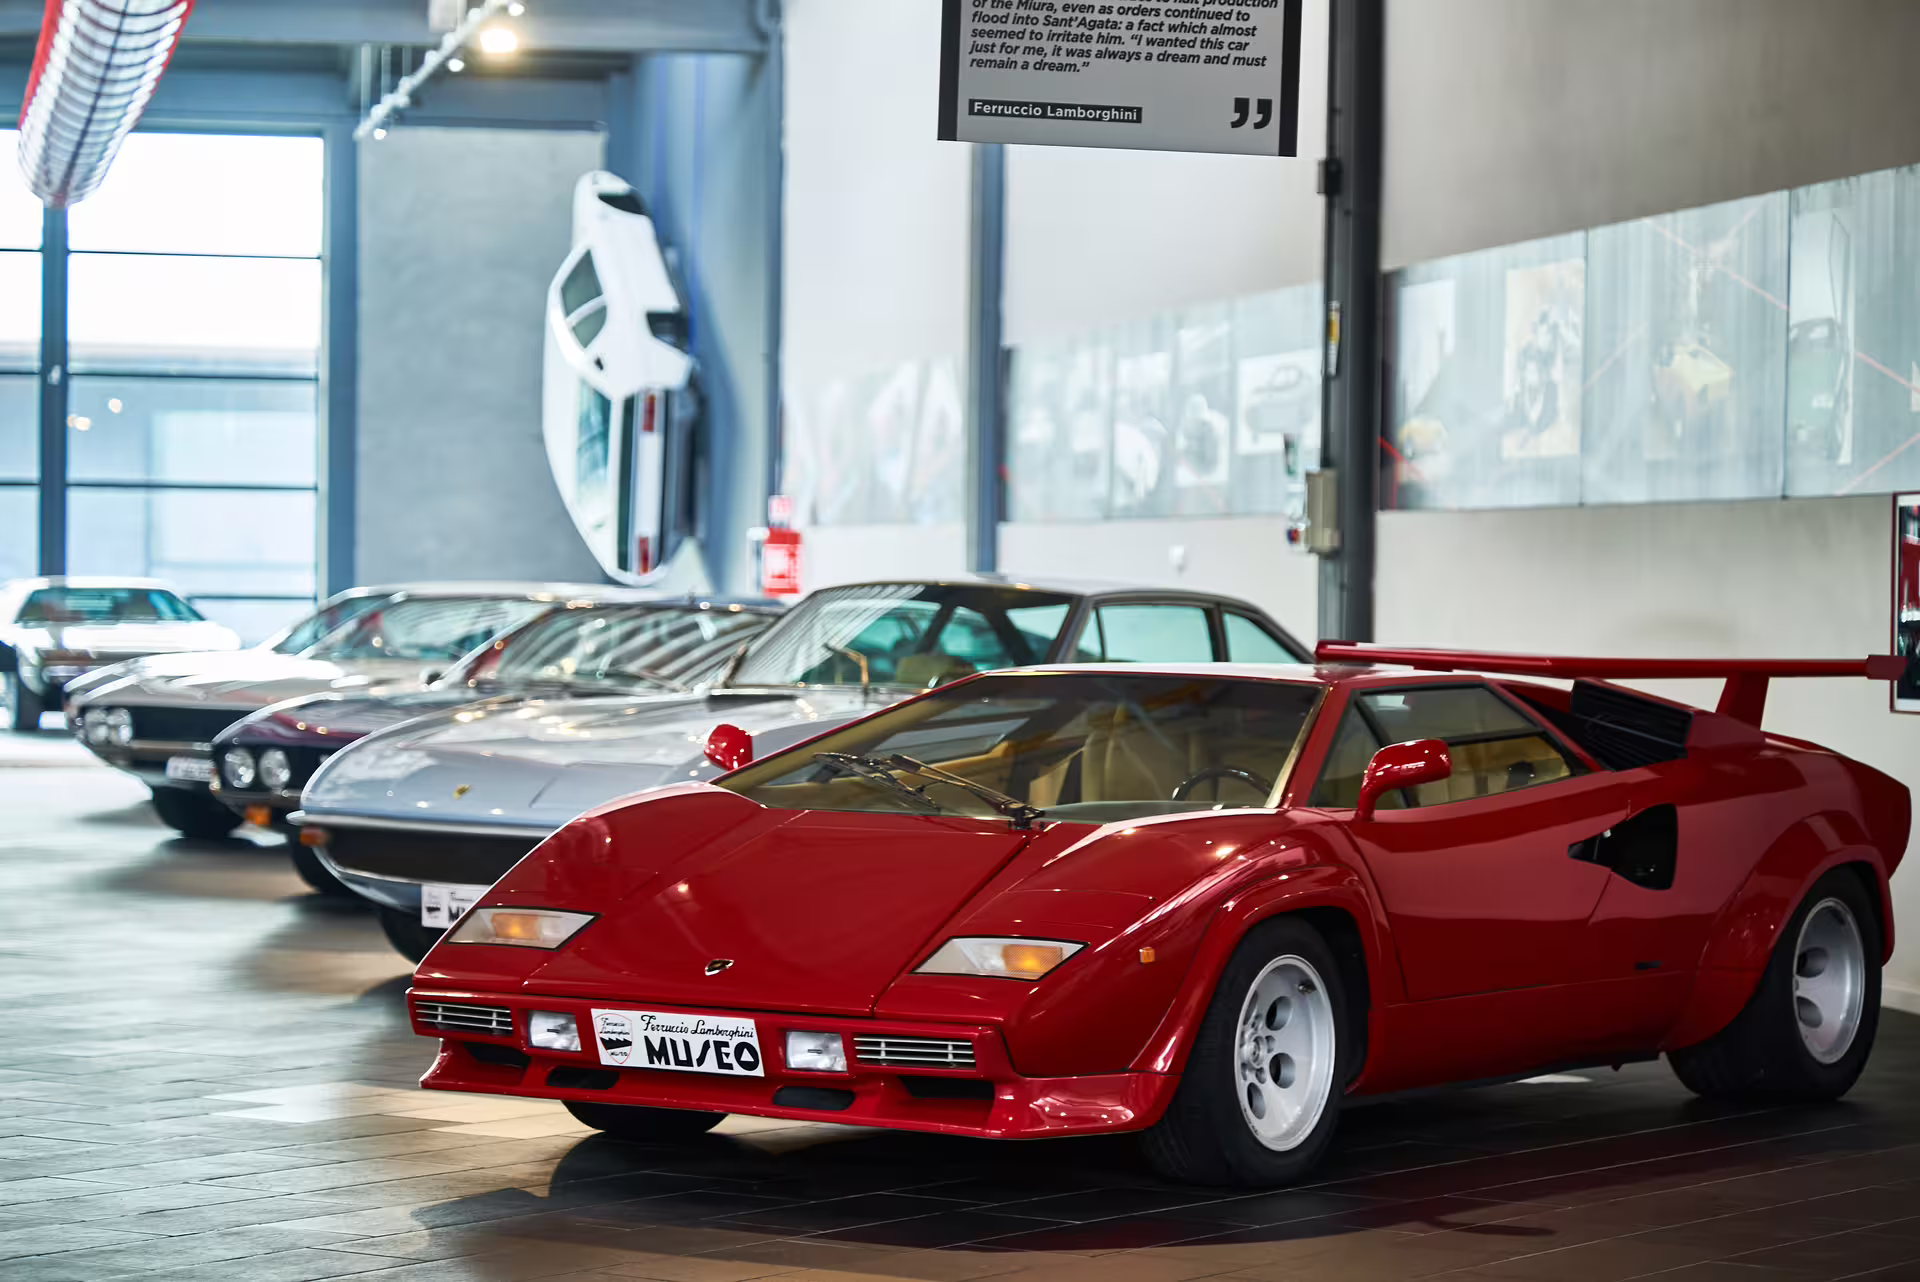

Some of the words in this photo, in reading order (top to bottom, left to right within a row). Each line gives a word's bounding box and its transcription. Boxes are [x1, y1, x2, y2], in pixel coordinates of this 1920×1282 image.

[972, 0, 986, 8] of
[991, 0, 1013, 9] the
[1016, 0, 1057, 14] Miura,
[1062, 3, 1095, 14] even
[1098, 5, 1114, 15] as
[1117, 4, 1161, 17] orders
[1164, 7, 1233, 21] continued
[1236, 10, 1250, 22] to
[972, 11, 1010, 24] flood
[1012, 13, 1039, 26] into
[1125, 20, 1134, 31] a
[1137, 19, 1164, 32] fact
[1168, 21, 1207, 35] which
[1210, 24, 1257, 36] almost
[971, 27, 1026, 40] seemed
[1028, 29, 1043, 41] to
[1047, 29, 1093, 43] irritate
[1096, 31, 1125, 45] him.
[1146, 35, 1197, 49] wanted
[1200, 37, 1224, 50] this
[1227, 40, 1250, 51] car
[968, 41, 996, 54] just
[999, 42, 1020, 55] for
[1022, 45, 1047, 58] me,
[1051, 45, 1062, 57] it
[1066, 48, 1092, 58] was
[1095, 48, 1142, 62] always
[1144, 52, 1153, 61] a
[1156, 50, 1200, 64] dream
[1203, 53, 1230, 65] and
[1232, 55, 1267, 67] must
[970, 57, 1018, 69] remain
[1020, 60, 1029, 70] a
[974, 101, 1042, 116] Ferruccio
[1047, 105, 1138, 121] Lamborghini
[640, 1014, 689, 1034] Ferruccio
[690, 1019, 755, 1041] Lamborghini
[643, 1035, 760, 1072] MUSEO
